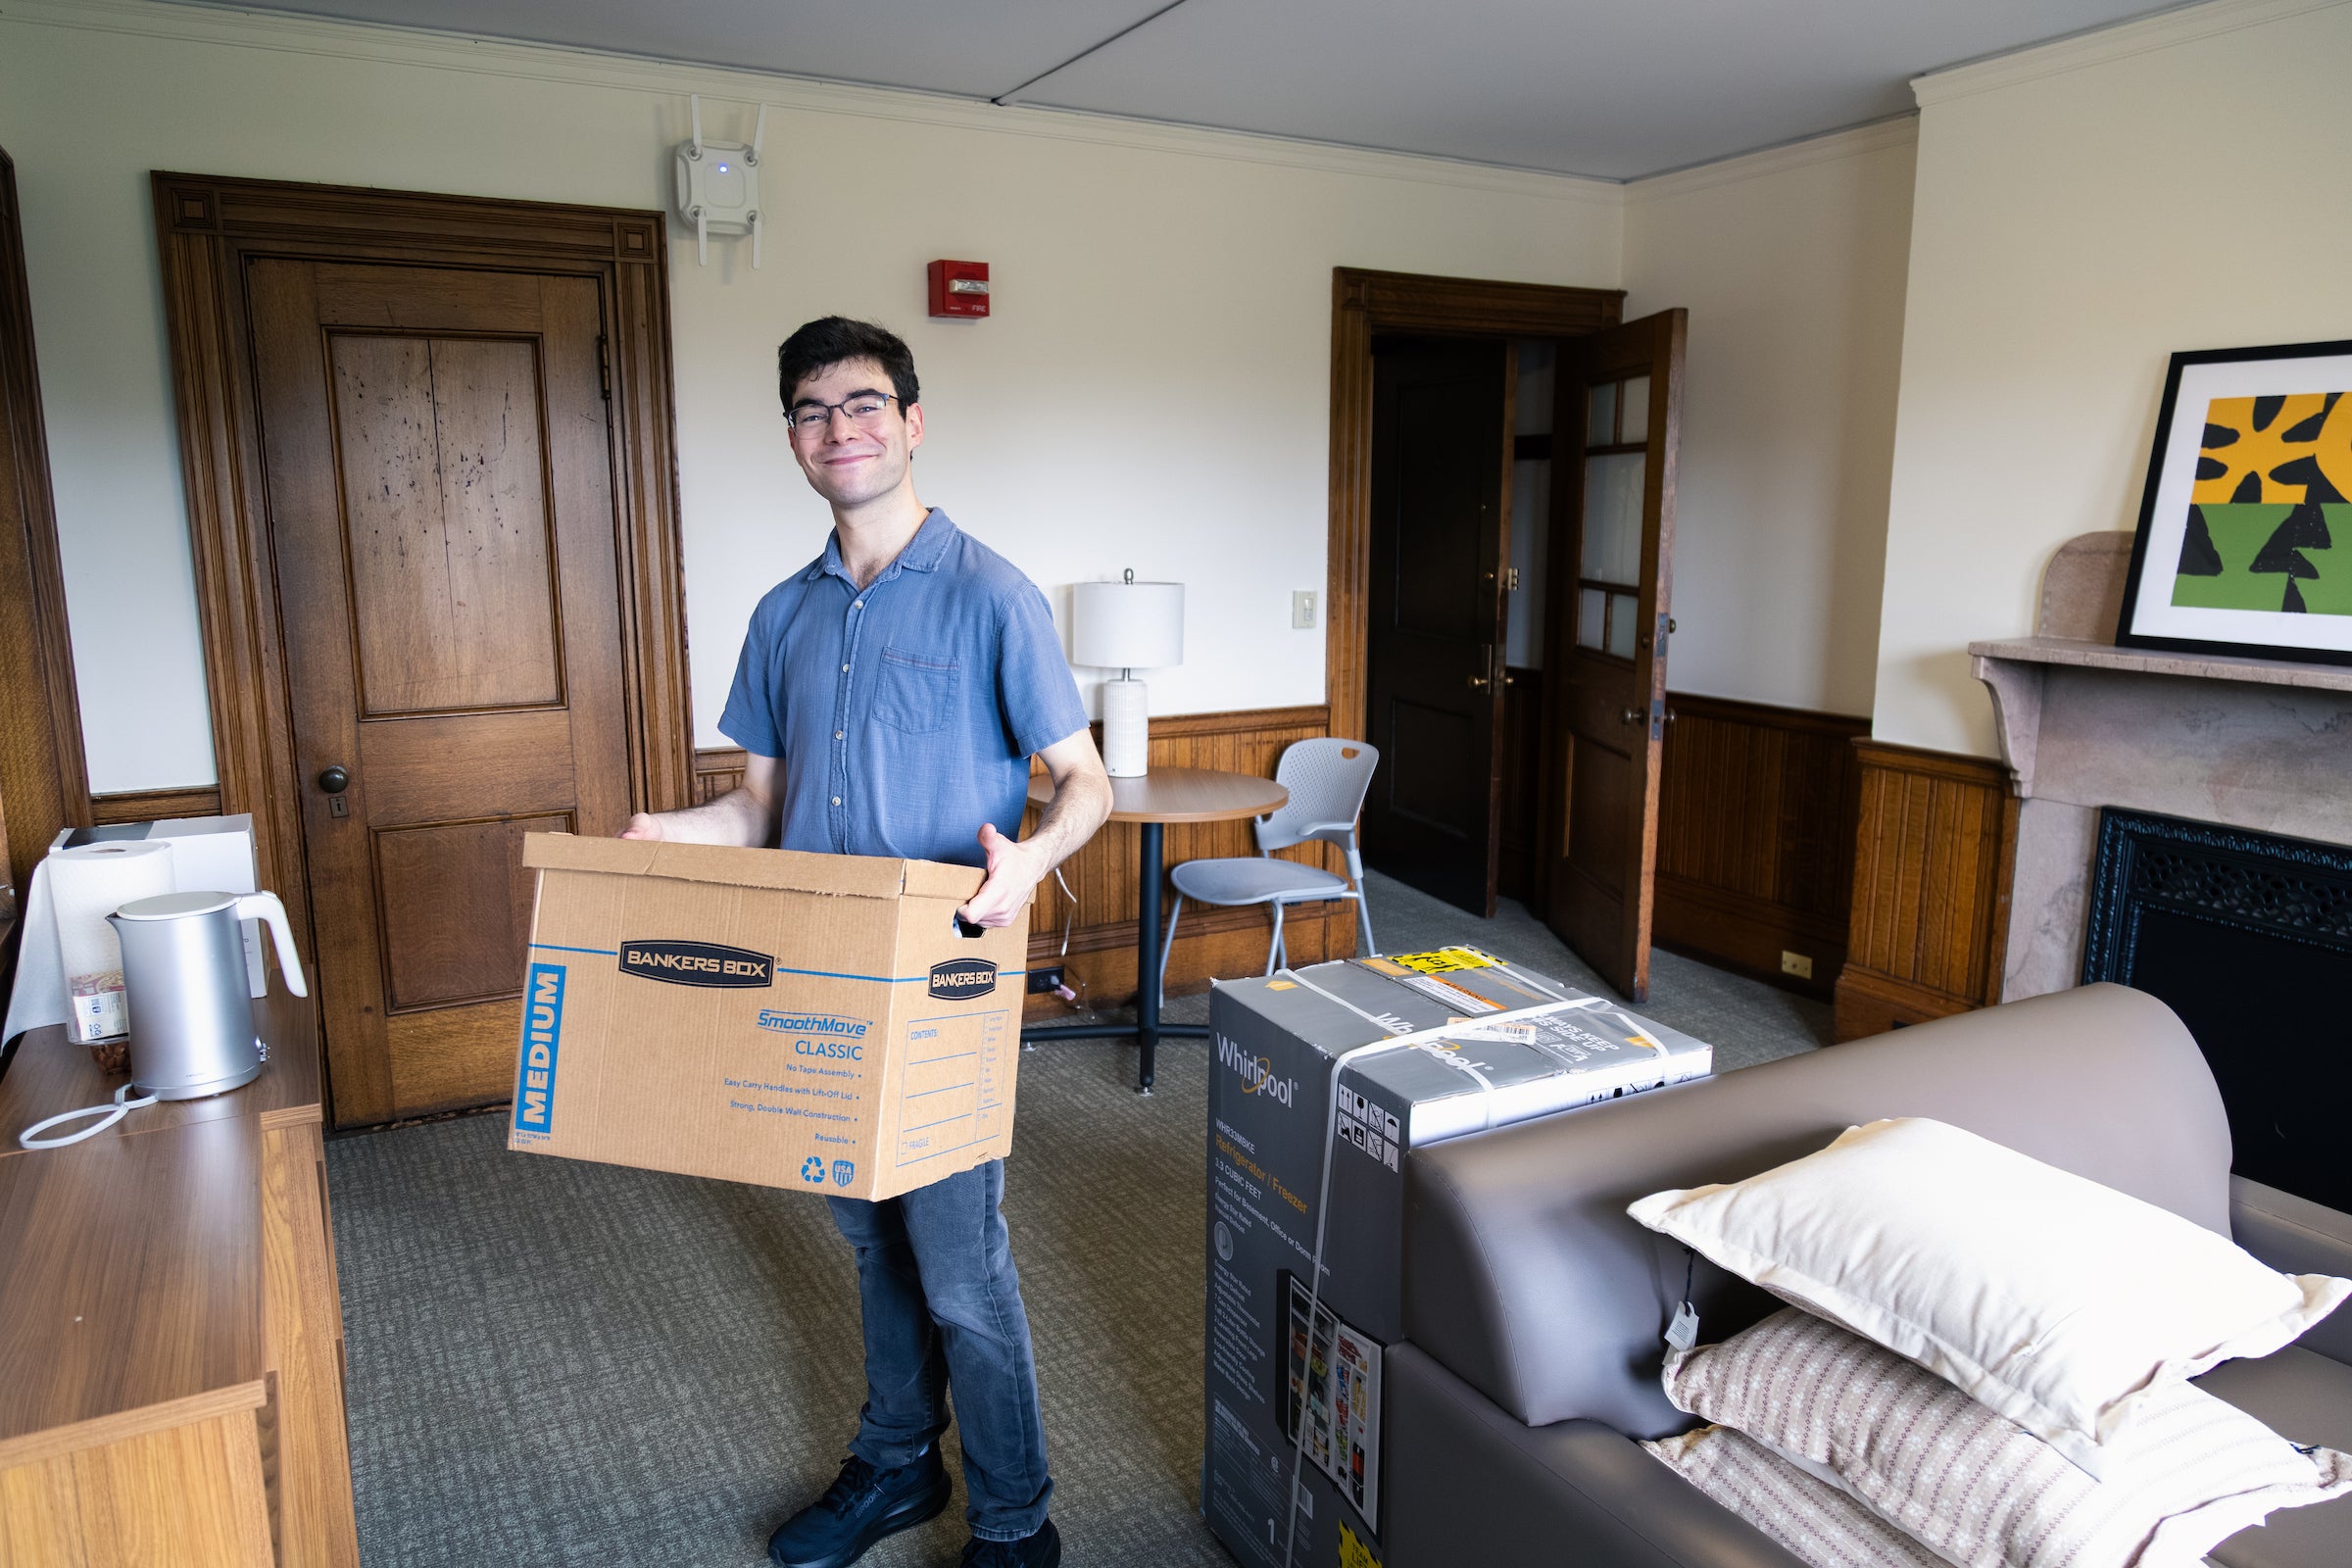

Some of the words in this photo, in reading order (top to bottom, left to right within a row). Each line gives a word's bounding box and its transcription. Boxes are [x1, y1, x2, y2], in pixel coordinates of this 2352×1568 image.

[972, 304, 986, 313] FIRE
[626, 951, 720, 973] BANKERS
[722, 959, 766, 978] BOX
[932, 972, 974, 988] BANKERS
[975, 970, 995, 985] BOX
[757, 1011, 867, 1036] SmoothMove
[523, 972, 559, 1125] MEDIUM
[795, 1040, 863, 1060] CLASSIC
[1549, 1026, 1586, 1042] SIDE
[1582, 1041, 1607, 1052] UP
[1580, 1032, 1620, 1051] KEEP
[786, 1063, 797, 1072] No
[799, 1064, 816, 1076] Tape
[818, 1067, 855, 1080] Assembly
[1216, 1032, 1293, 1108] Whirlpool
[724, 1078, 740, 1088] Easy
[742, 1080, 762, 1091] Carry
[763, 1083, 793, 1093] Handles
[795, 1087, 810, 1096] with
[812, 1089, 840, 1100] Lift-Off
[841, 1092, 853, 1101] Lid
[729, 1100, 755, 1112] Strong,
[757, 1103, 783, 1114] Double
[785, 1106, 802, 1116] Wall
[804, 1109, 851, 1122] Construction
[814, 1133, 849, 1145] Reusable
[908, 1137, 930, 1150] FRAGILE
[834, 1163, 852, 1174] USA
[1215, 1134, 1266, 1183] Refrigerator
[1272, 1177, 1308, 1214] Freezer
[1225, 1164, 1245, 1187] CUBIC
[1245, 1180, 1262, 1200] FEET
[1215, 1176, 1233, 1196] Perfect
[1233, 1190, 1242, 1202] for
[1242, 1197, 1270, 1228] Basement,
[1270, 1221, 1288, 1241] Office
[1288, 1237, 1296, 1247] or
[1296, 1241, 1312, 1261] Dorm
[1267, 1517, 1275, 1545] 1
[1352, 1543, 1369, 1564] TEAM
